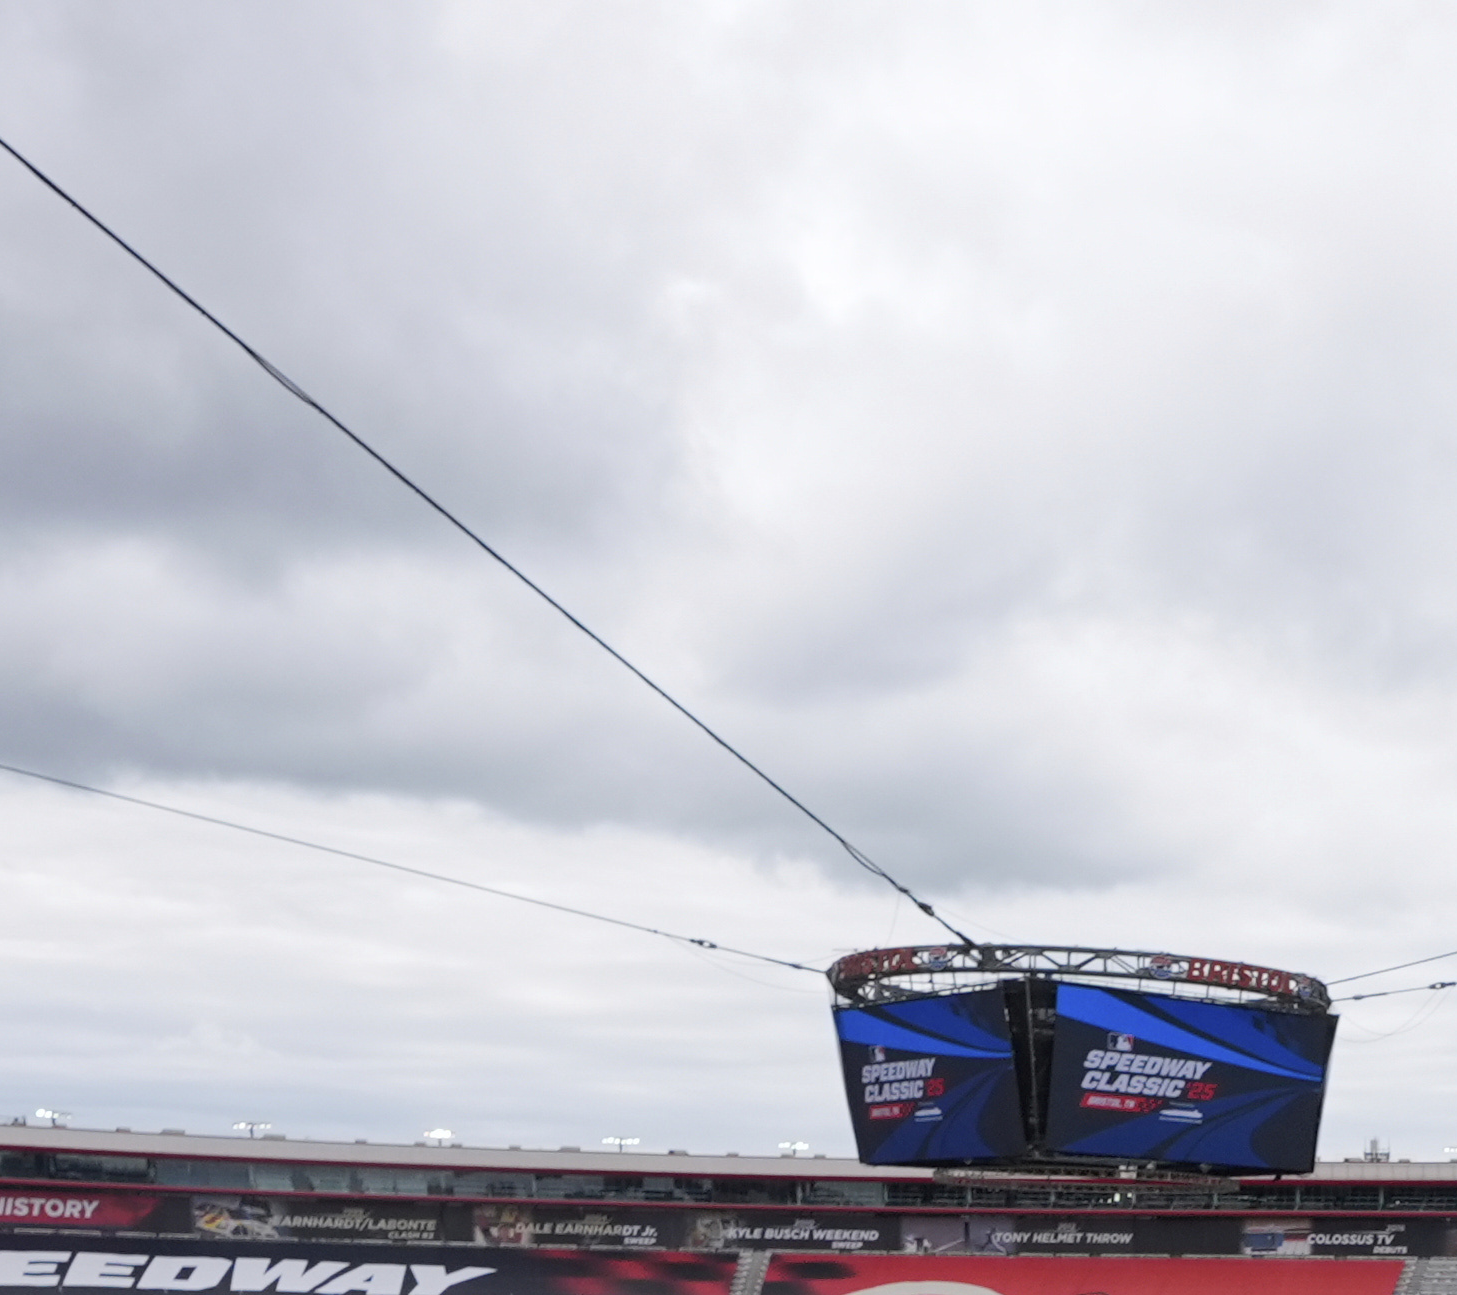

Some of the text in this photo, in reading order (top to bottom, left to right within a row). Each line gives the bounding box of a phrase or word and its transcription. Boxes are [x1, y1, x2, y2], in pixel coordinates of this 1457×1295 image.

[1188, 958, 1294, 993] BRISTOL
[862, 1057, 936, 1084] SPEEDWAY
[1083, 1049, 1212, 1080] SPEEDWAY
[864, 1079, 924, 1103] CLASSIC
[1081, 1070, 1219, 1100] CLASSIC '25
[516, 1222, 553, 1235] DALE
[555, 1223, 641, 1237] EARNHARDT
[764, 1228, 811, 1240] BUSCH
[812, 1229, 880, 1240] WEEKEND
[994, 1232, 1134, 1244] TONY HELMET THROW
[1308, 1233, 1395, 1245] COLOSSUS TV
